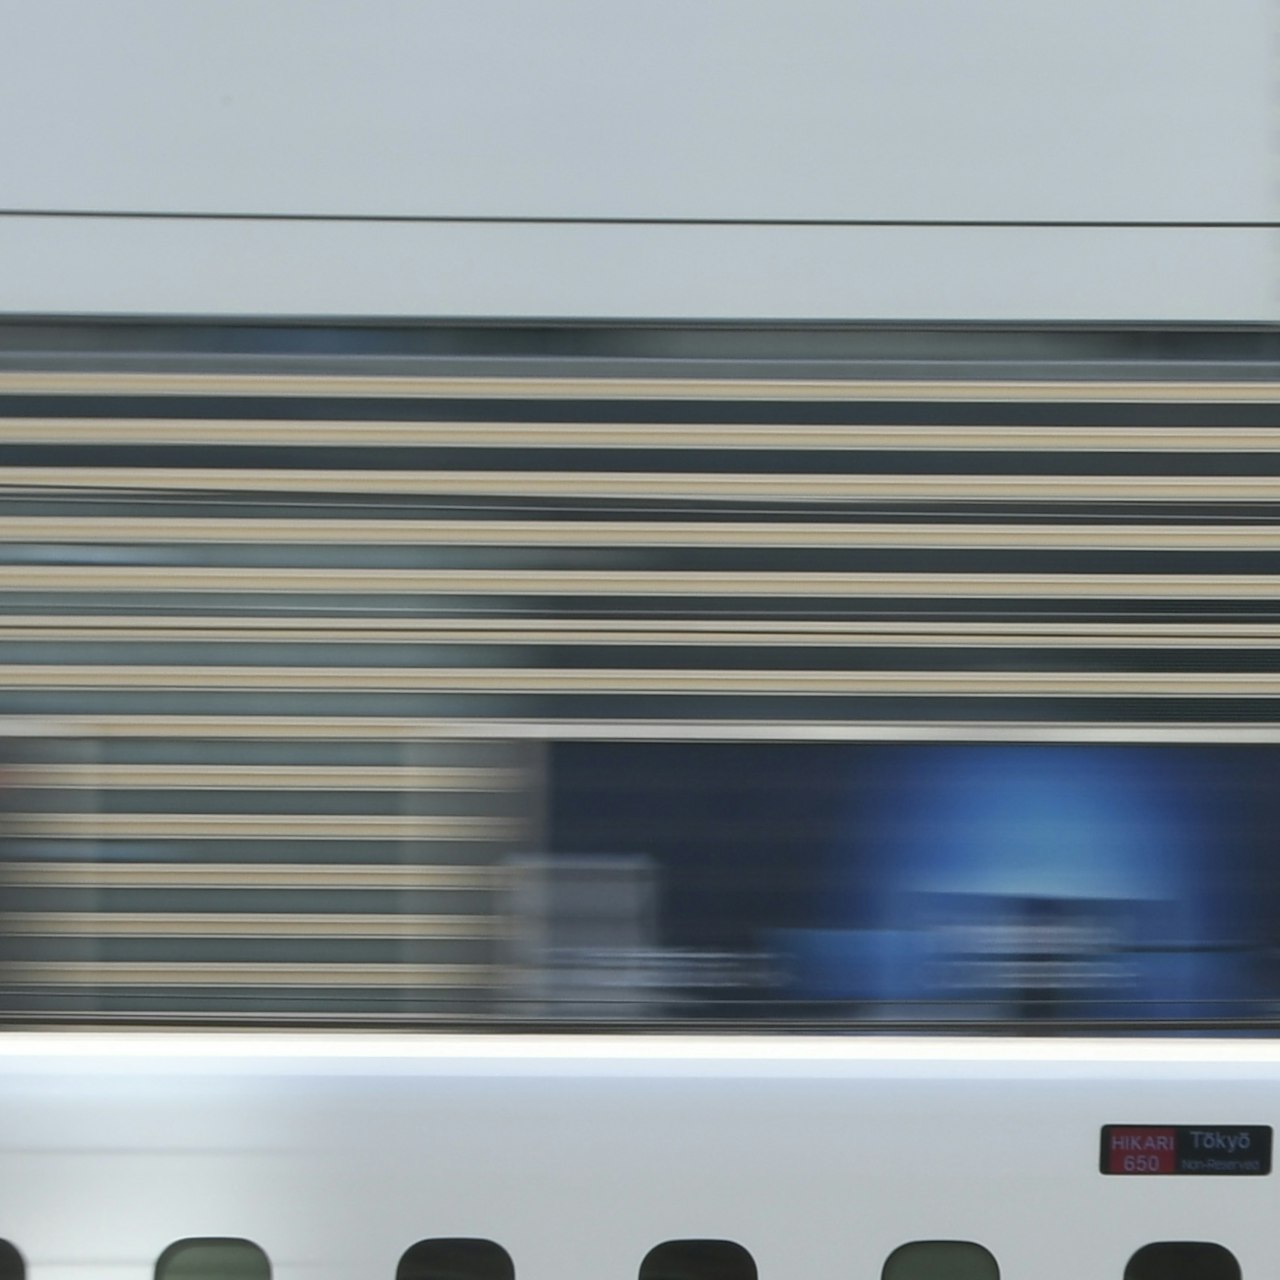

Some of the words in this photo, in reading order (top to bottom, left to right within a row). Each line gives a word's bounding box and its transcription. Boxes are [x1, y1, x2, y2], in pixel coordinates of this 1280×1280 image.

[1111, 1135, 1175, 1151] HIKARI
[1190, 1130, 1251, 1153] Tōkyō
[1123, 1154, 1160, 1172] 650
